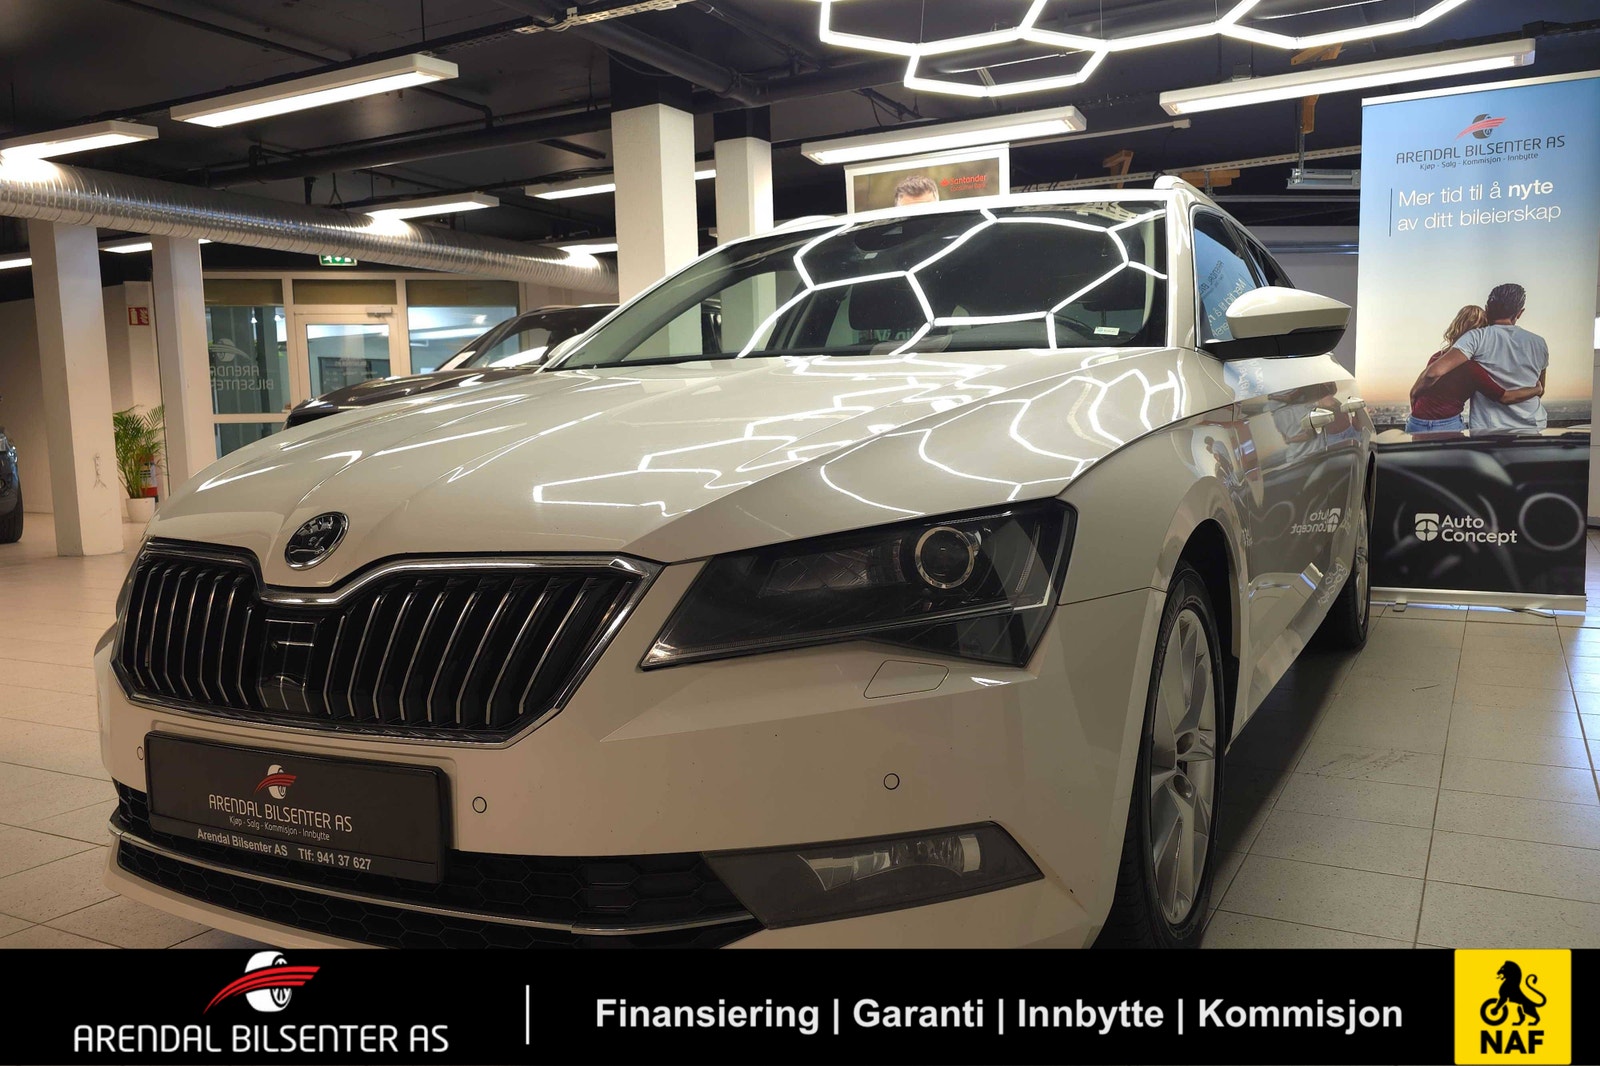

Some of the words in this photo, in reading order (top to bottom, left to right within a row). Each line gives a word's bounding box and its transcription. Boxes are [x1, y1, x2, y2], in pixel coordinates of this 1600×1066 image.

[1396, 147, 1461, 164] ARENDAL
[1465, 138, 1542, 158] BILSENTER
[1546, 135, 1565, 149] AS
[1420, 162, 1436, 171] Kjøp
[1442, 160, 1456, 168] Salg
[1462, 156, 1501, 166] Kommisjon
[1507, 152, 1538, 161] Innbytte
[950, 174, 986, 186] Santander
[1399, 190, 1435, 207] Mer
[1440, 186, 1462, 204] tid
[1469, 184, 1483, 201] til
[1489, 181, 1501, 199] å
[1508, 179, 1554, 200] nyte
[1398, 216, 1418, 231] av
[1424, 212, 1454, 228] ditt
[1460, 204, 1562, 226] bileierskap
[1442, 514, 1484, 528] Auto
[1442, 529, 1518, 546] Concept
[208, 794, 262, 818] ARENDAL
[265, 803, 332, 830] BILSENTER
[335, 814, 353, 833] AS
[229, 816, 242, 826] Kjøp
[246, 818, 260, 830] Salg
[264, 822, 298, 836] Kommisjon
[302, 828, 330, 842] Innbytte
[198, 828, 230, 845] Arendal
[232, 836, 272, 854] Bilsenter
[274, 844, 288, 857] AS
[298, 848, 314, 862] Tlf:
[317, 851, 335, 864] 941
[338, 854, 350, 867] 37
[353, 858, 372, 870] 627
